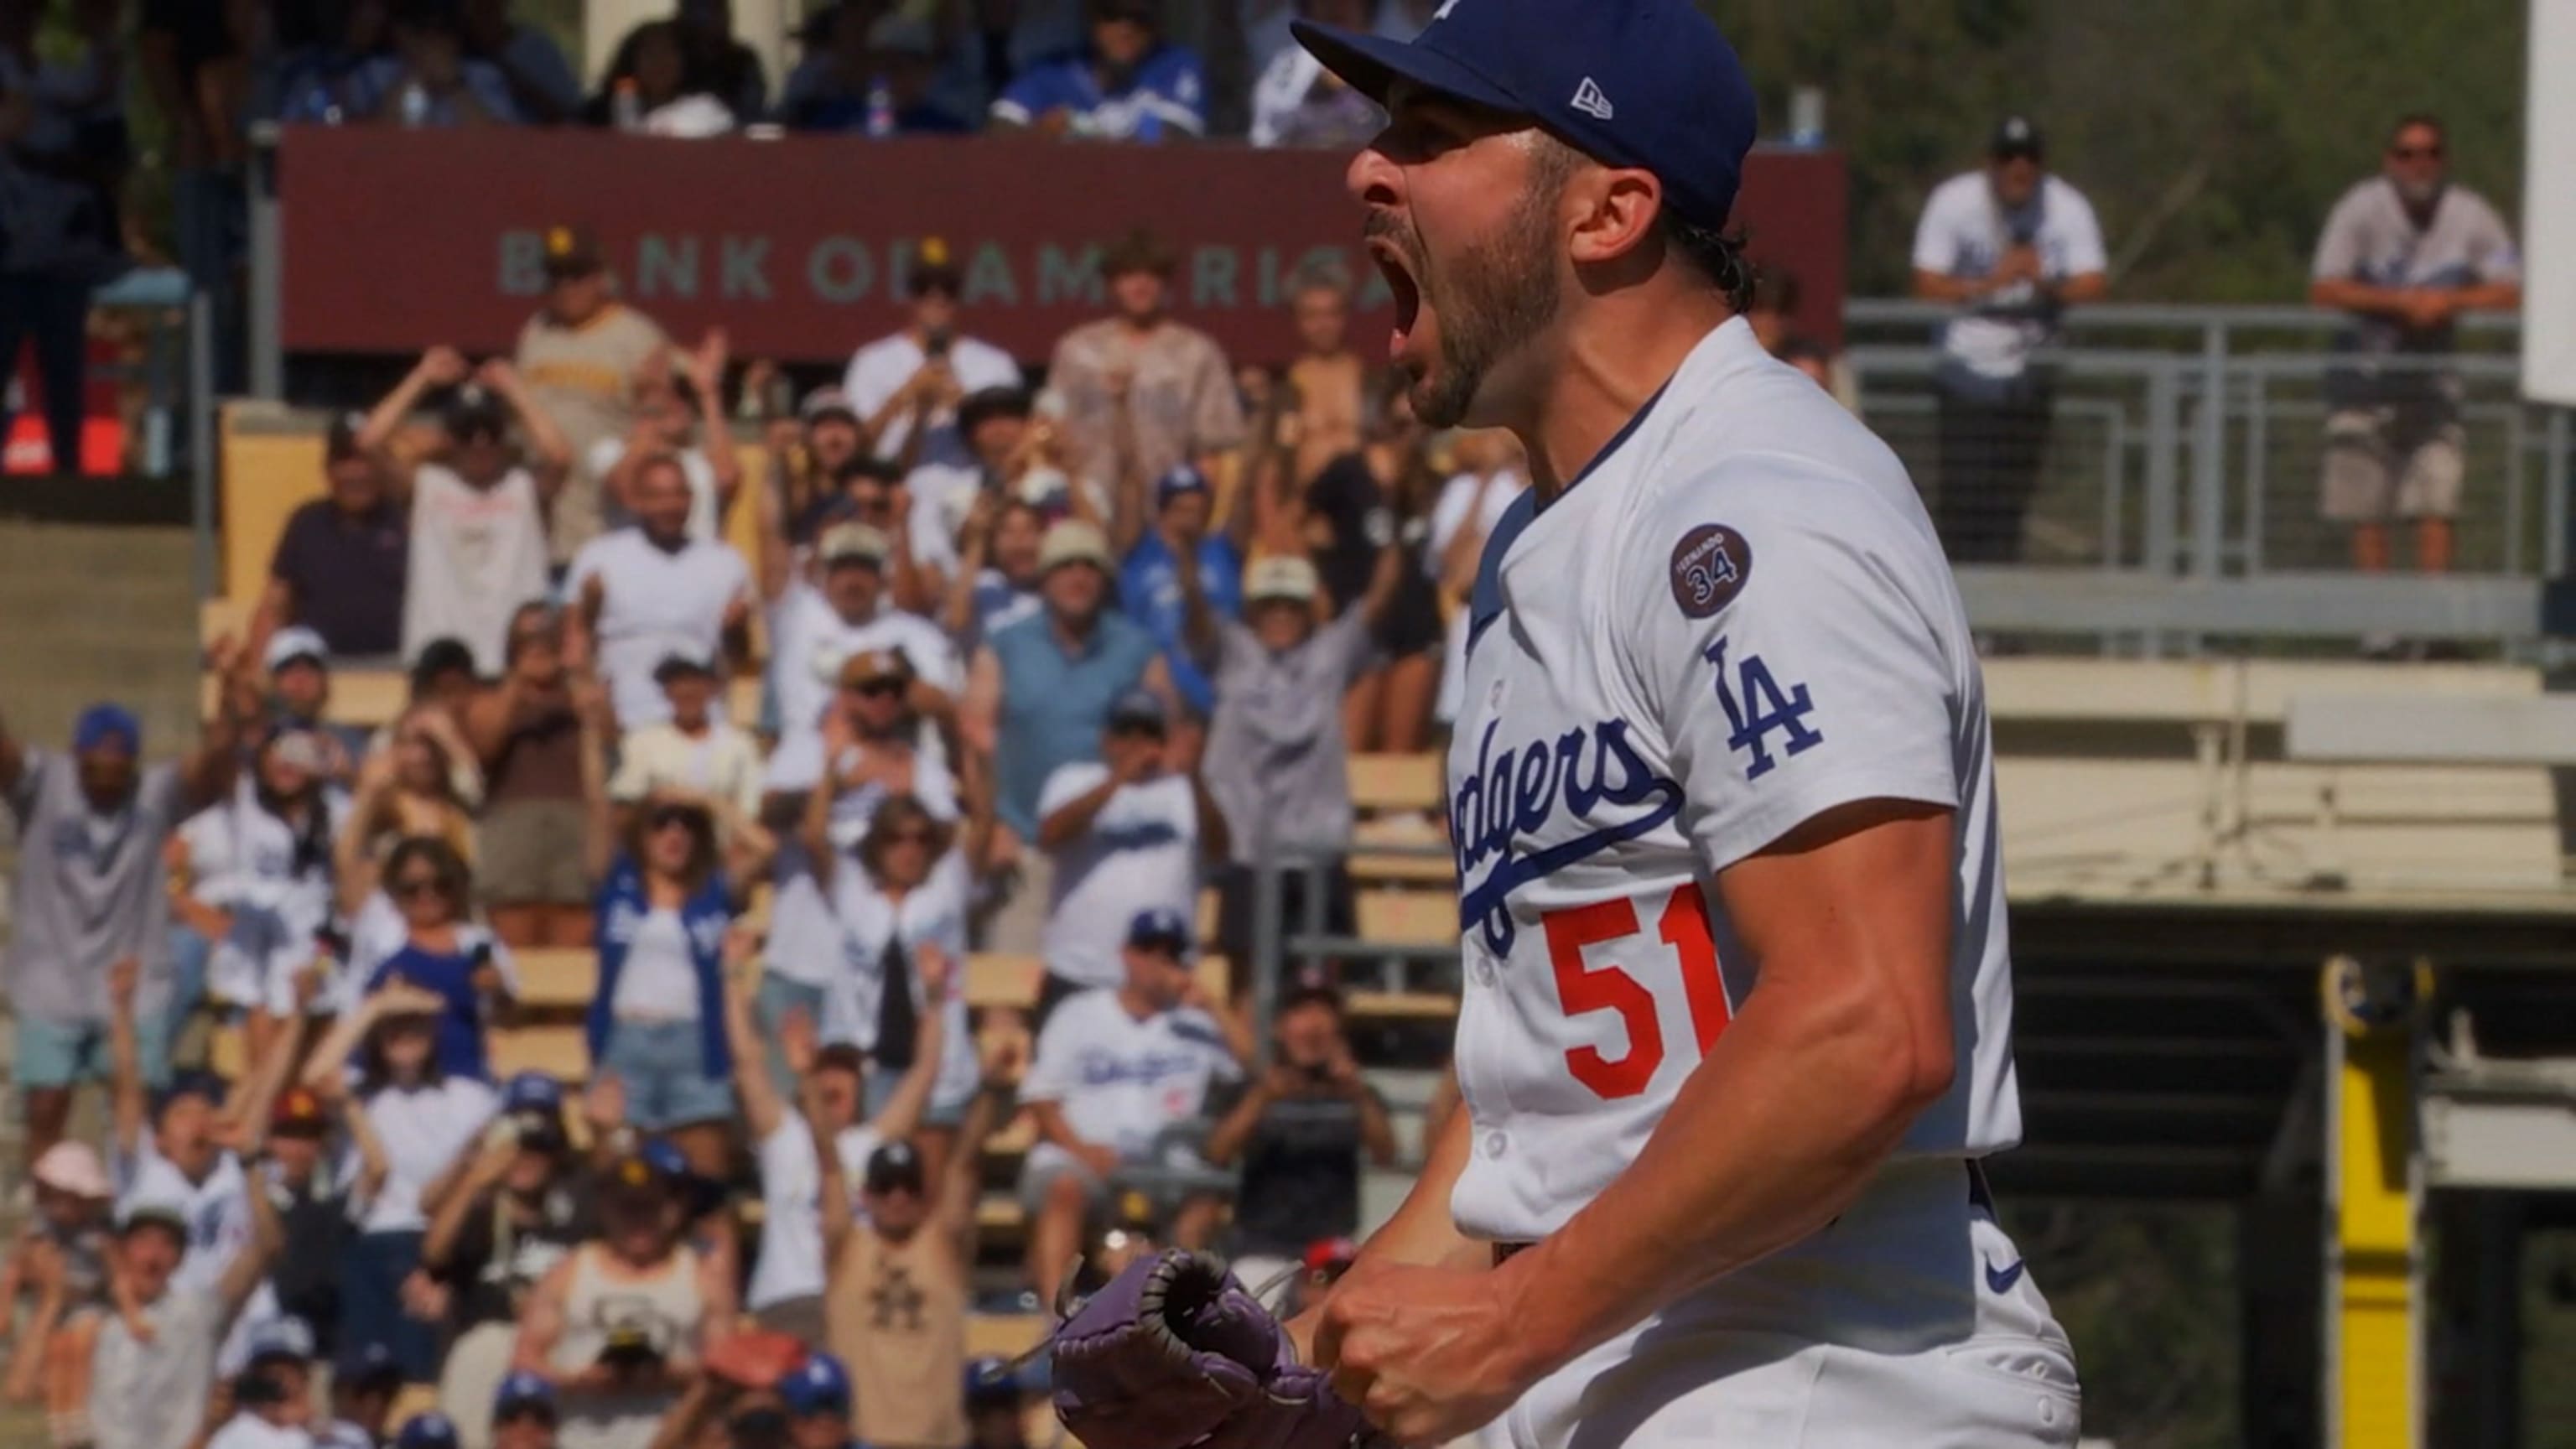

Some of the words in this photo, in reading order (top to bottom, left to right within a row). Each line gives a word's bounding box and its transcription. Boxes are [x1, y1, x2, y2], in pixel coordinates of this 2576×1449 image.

[498, 229, 771, 299] BNK
[1685, 546, 1738, 605] 34
[1704, 634, 1825, 782] LA
[1454, 717, 1686, 960] odgers
[1541, 880, 1732, 1101] 51
